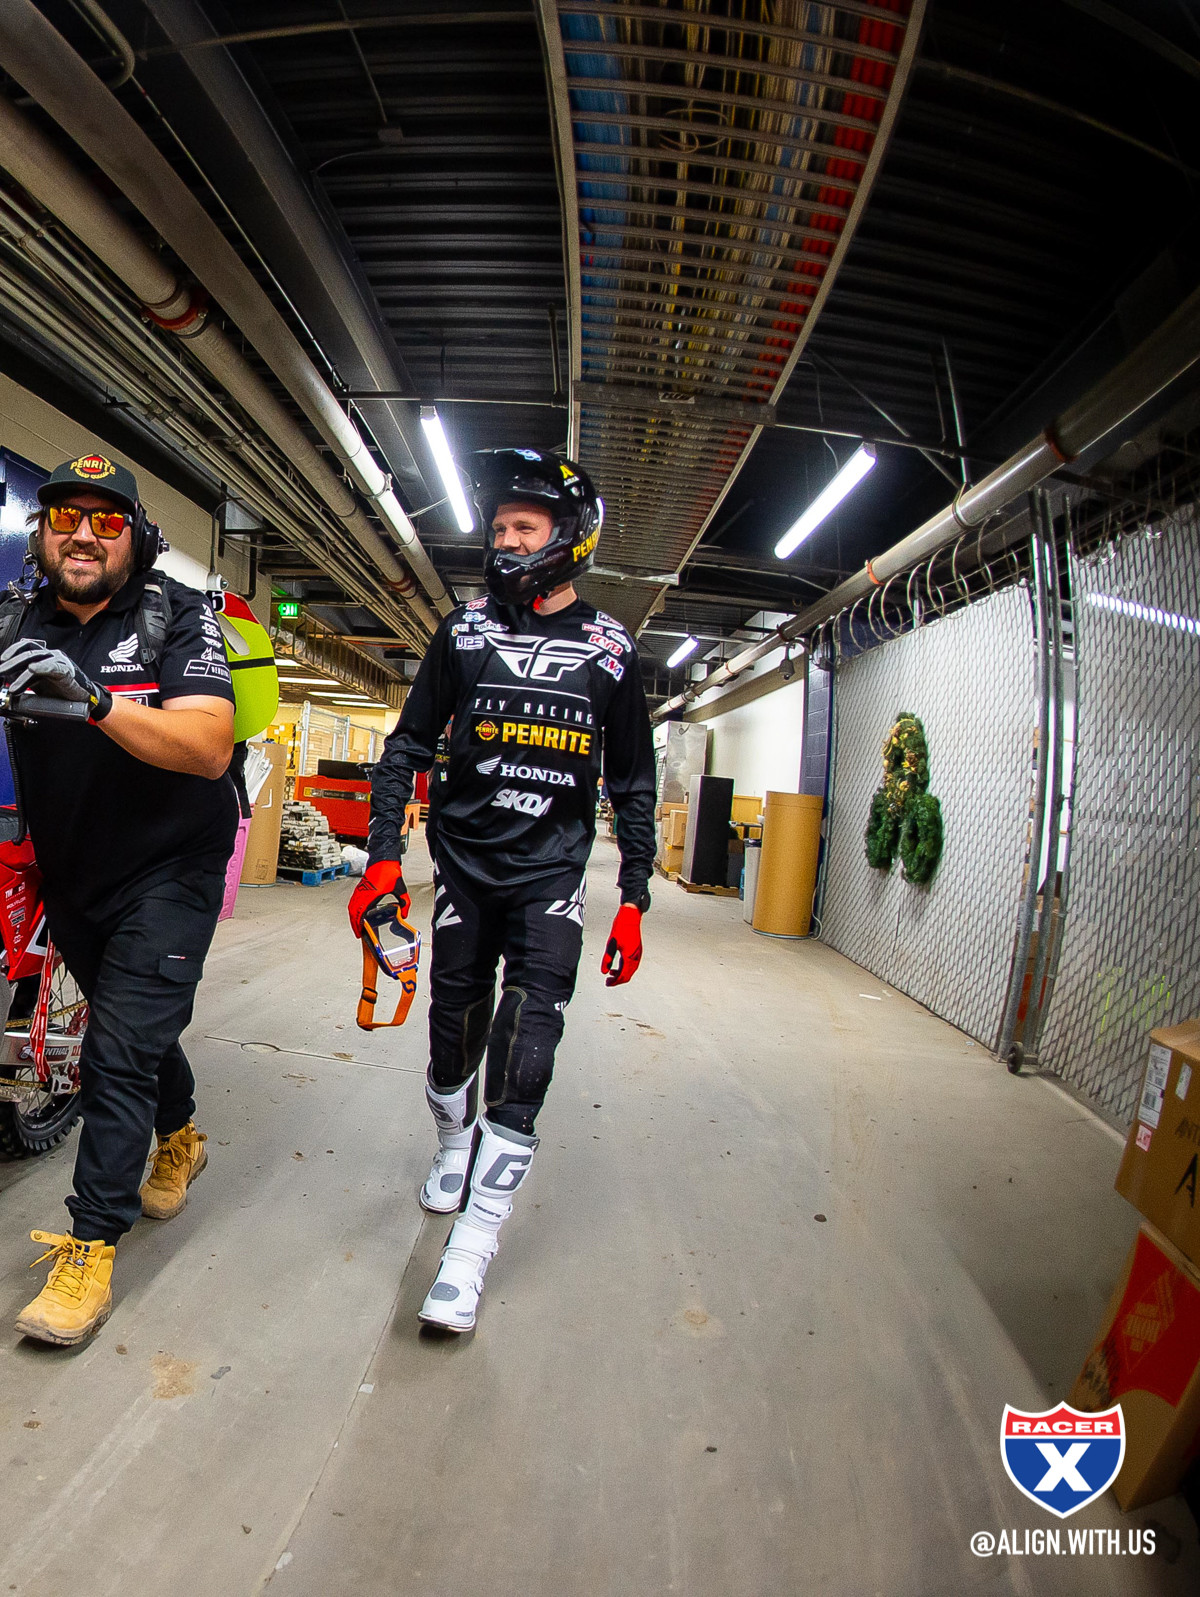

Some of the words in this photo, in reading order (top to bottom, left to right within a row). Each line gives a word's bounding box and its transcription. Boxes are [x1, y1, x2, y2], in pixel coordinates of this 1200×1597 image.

[70, 455, 117, 477] PENRITE
[572, 525, 601, 563] PENR
[100, 663, 144, 674] HONDA
[475, 697, 505, 712] FLY
[523, 701, 593, 725] RACING
[475, 724, 499, 736] PENRITE
[502, 721, 592, 755] PENRITE
[499, 764, 576, 788] HONDA
[491, 787, 553, 818] SKDA
[43, 1046, 69, 1056] ENTHAL
